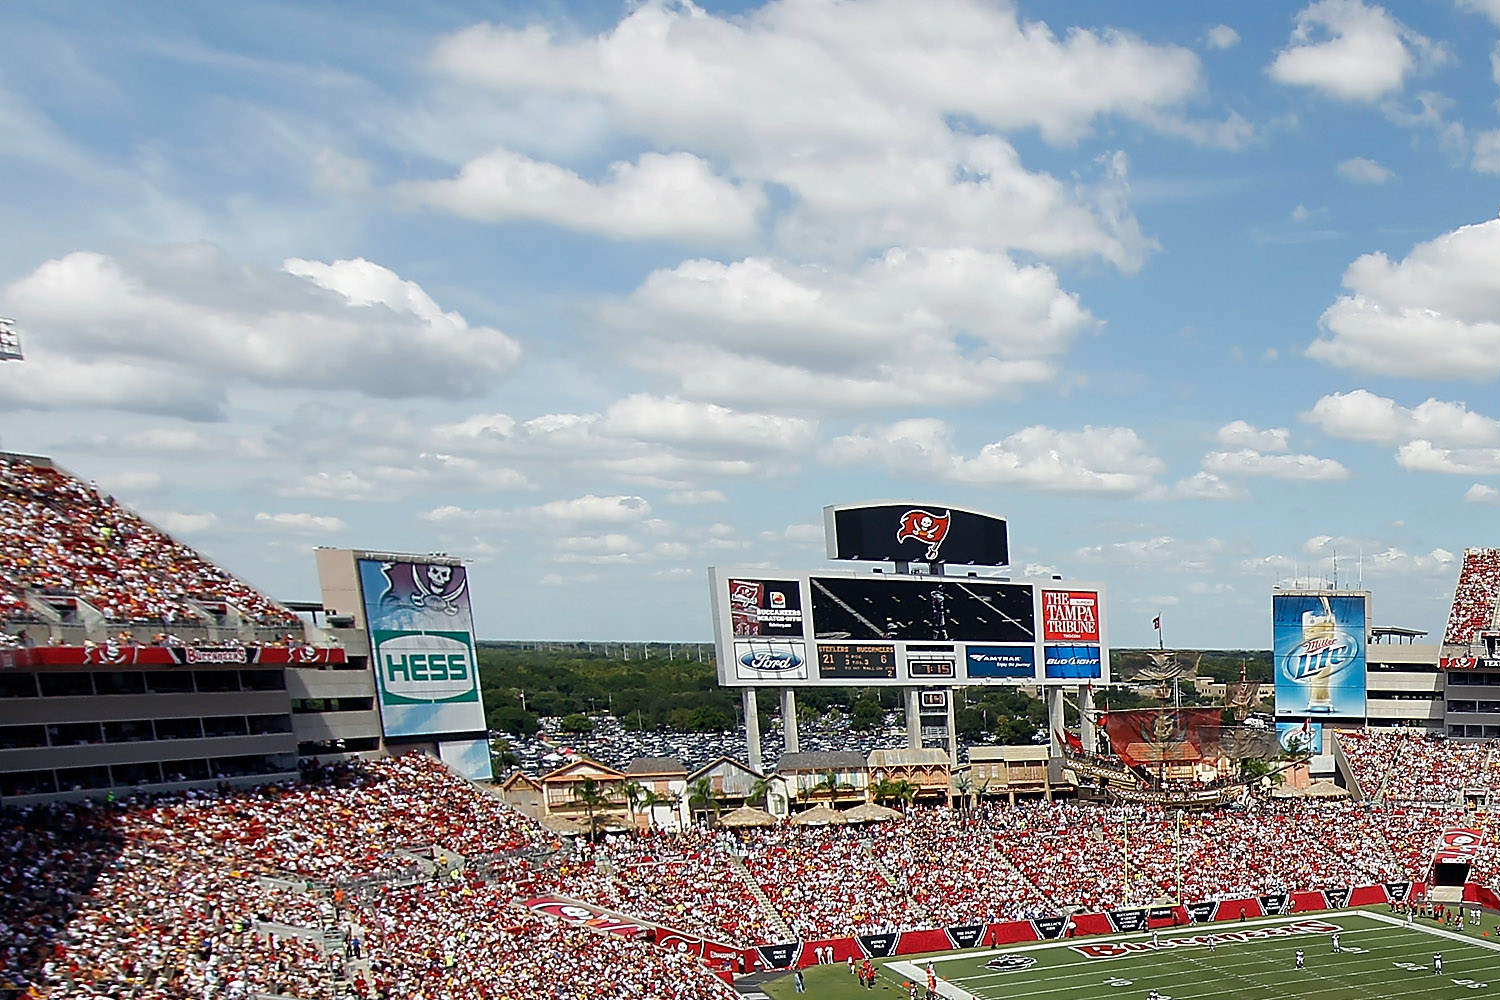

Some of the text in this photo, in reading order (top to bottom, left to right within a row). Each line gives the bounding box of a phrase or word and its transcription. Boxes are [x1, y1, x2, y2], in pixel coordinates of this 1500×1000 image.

[1045, 592, 1069, 606] THE
[1046, 606, 1095, 622] TAMPA
[1047, 620, 1096, 634] TRIBUNE
[1304, 638, 1338, 653] Miller
[752, 652, 792, 668] Ford
[822, 654, 835, 664] 21
[880, 654, 888, 664] 6
[1068, 656, 1099, 665] LIGHT
[1295, 645, 1350, 679] Lite
[386, 654, 468, 682] HESS
[922, 664, 950, 674] 7:15
